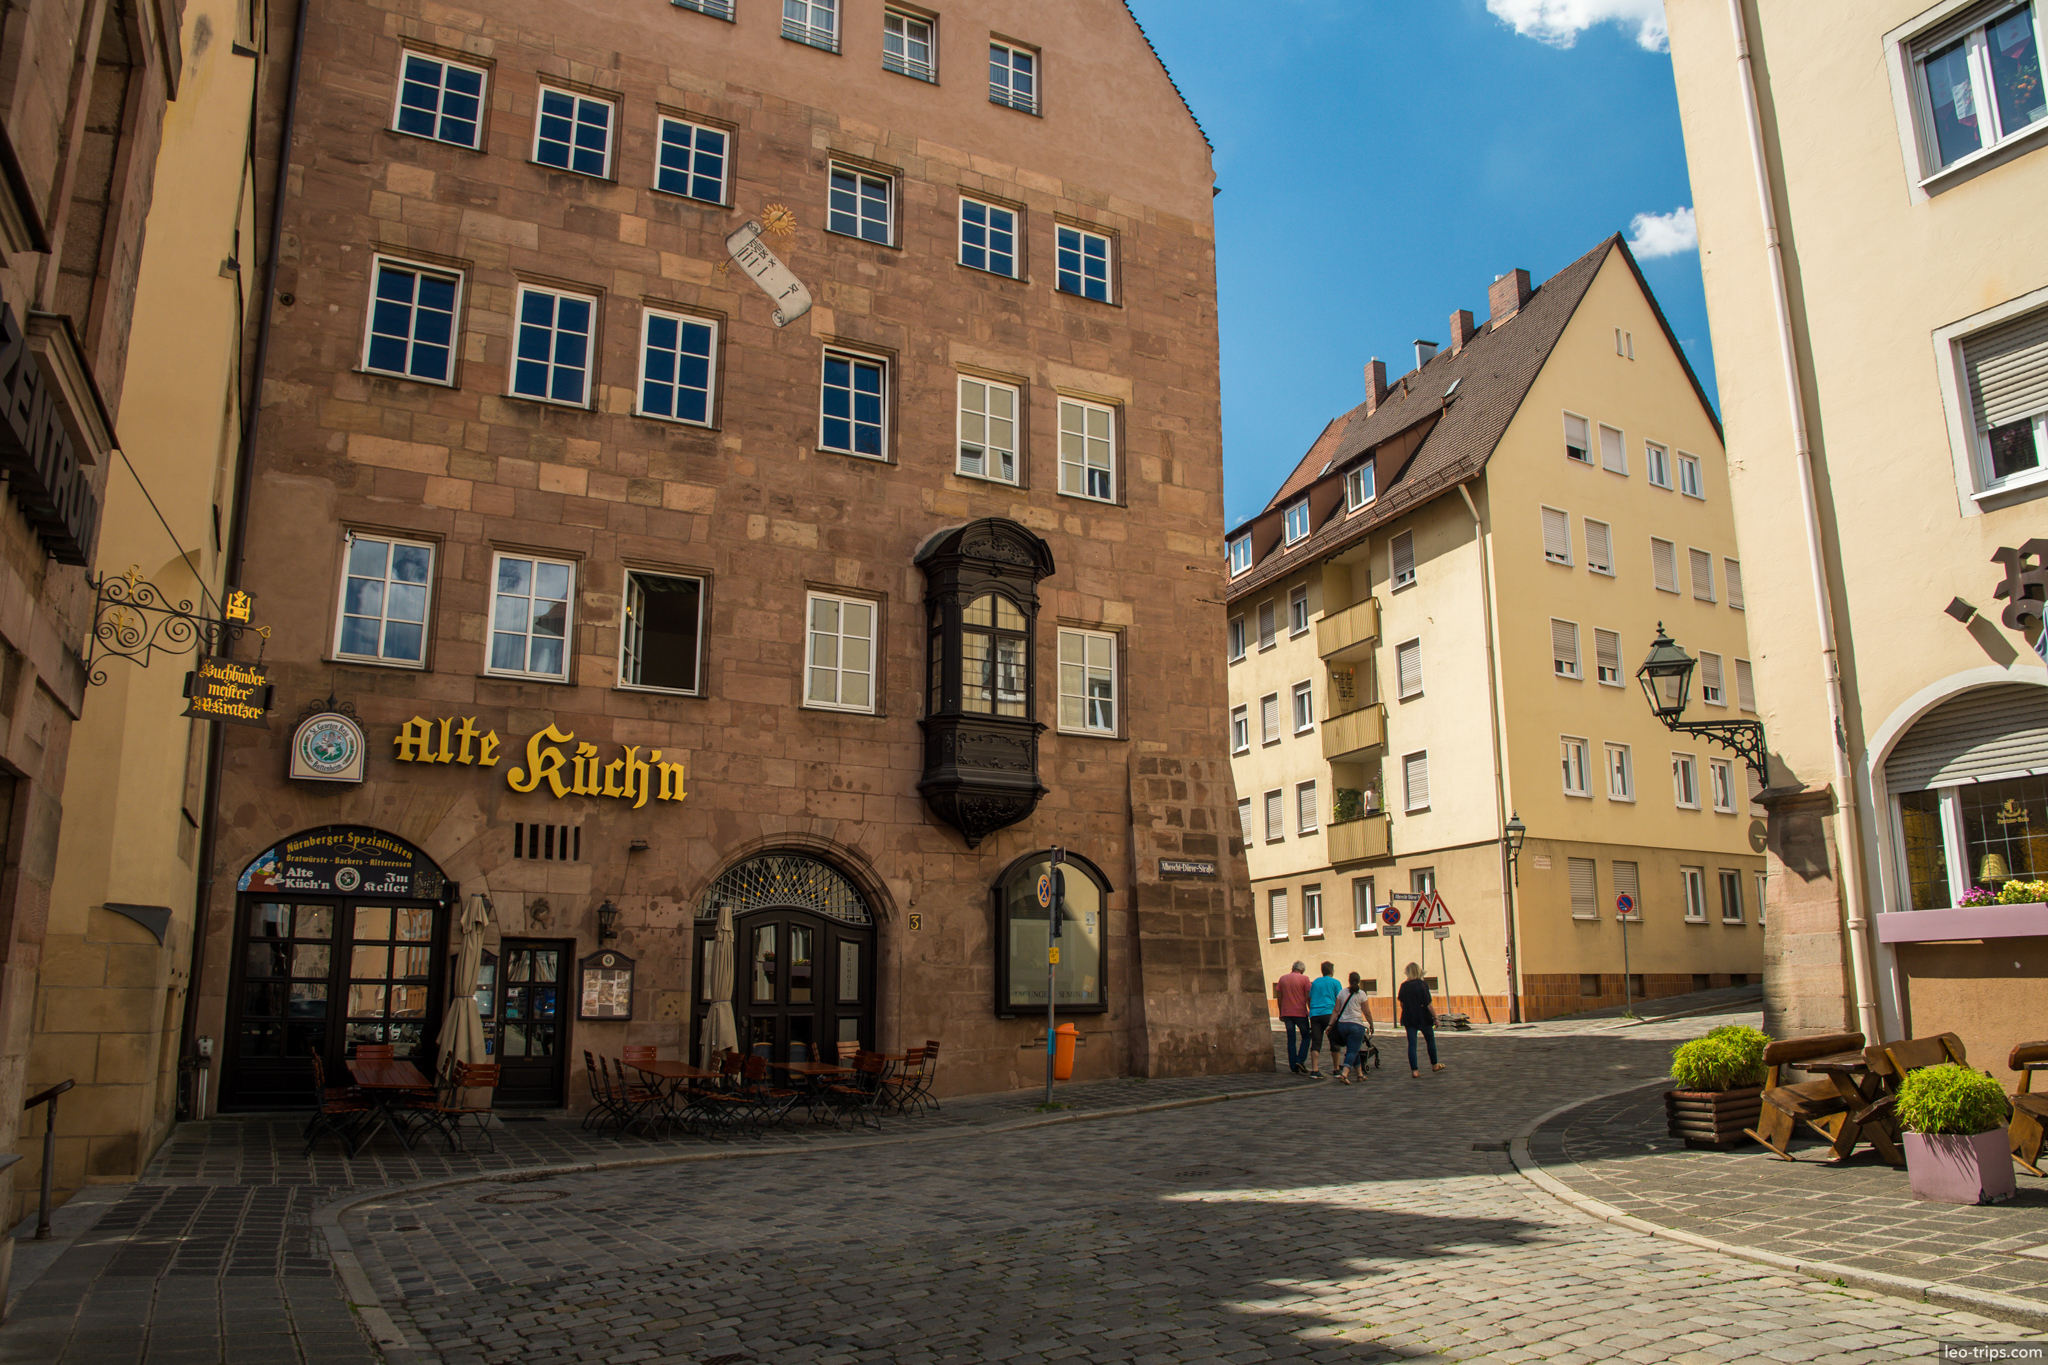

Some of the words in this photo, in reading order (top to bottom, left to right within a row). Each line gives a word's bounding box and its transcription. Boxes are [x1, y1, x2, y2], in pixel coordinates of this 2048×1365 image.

[393, 715, 501, 767] Alte
[507, 722, 688, 809] Küch'n
[286, 835, 344, 853] Nürnberger
[347, 832, 413, 860] Spezialitäten
[286, 854, 328, 864] Bratwürste
[334, 856, 363, 865] Backers
[369, 858, 412, 868] Ritteressen
[285, 867, 314, 878] Alte
[384, 872, 409, 883] Im
[284, 878, 331, 890] Küch'n
[363, 881, 409, 893] Keller
[910, 915, 920, 930] 3
[1014, 990, 1049, 998] TAGUNGE
